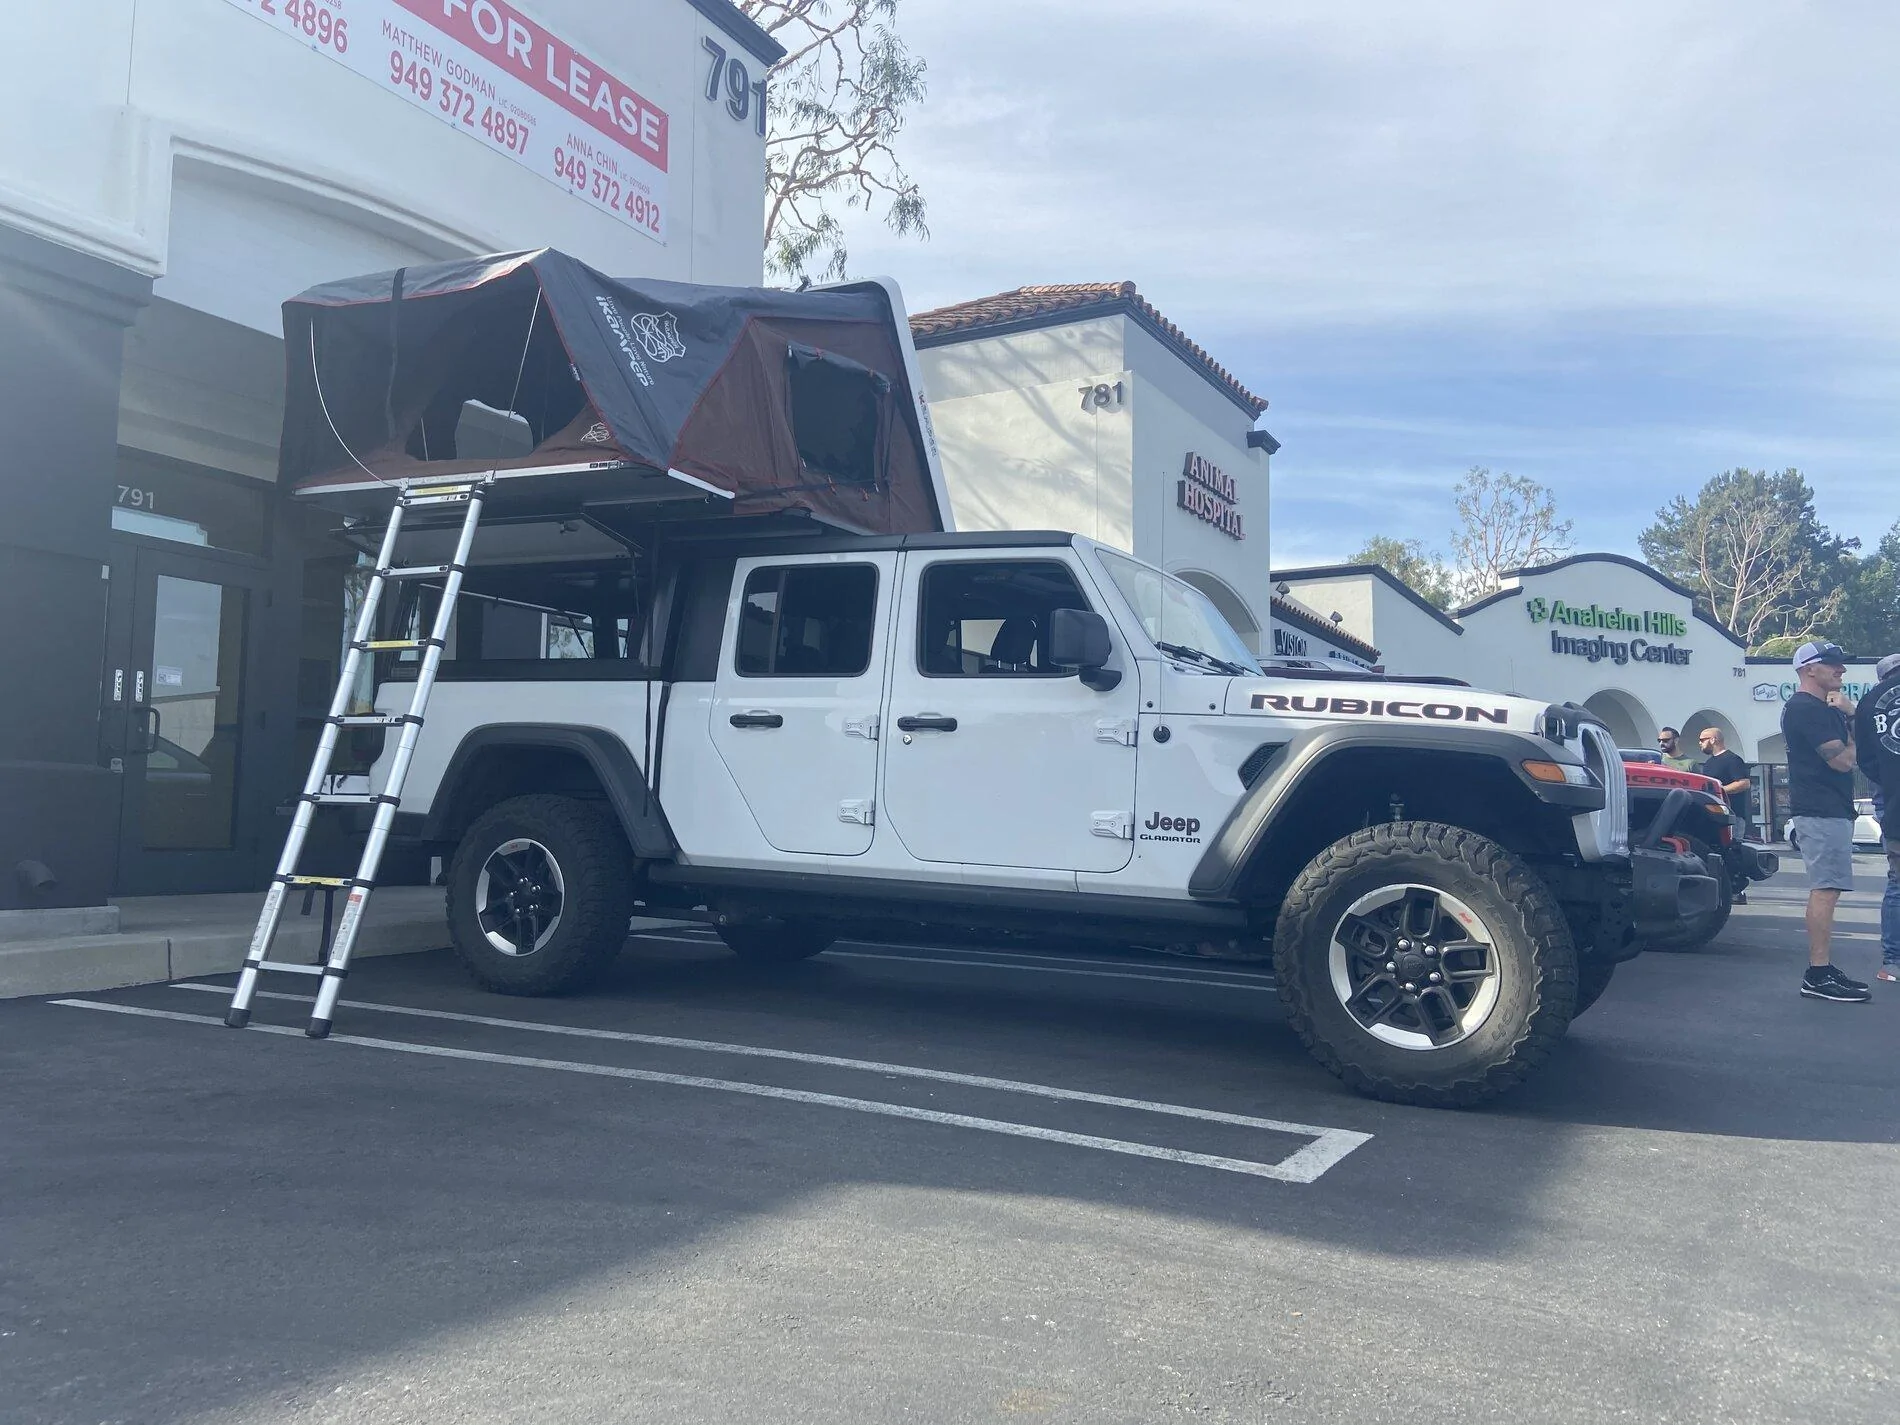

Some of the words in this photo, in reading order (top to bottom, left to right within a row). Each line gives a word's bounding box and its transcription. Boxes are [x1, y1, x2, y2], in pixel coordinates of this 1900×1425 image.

[284, 0, 348, 54] 4896
[381, 19, 443, 69] MATTHEW
[445, 58, 496, 101] GODMAN
[389, 49, 433, 101] 949
[438, 76, 475, 128] 372
[480, 105, 530, 156] 4897
[546, 43, 661, 153] LEASE
[701, 35, 767, 138] 791
[566, 132, 594, 161] ANNA
[595, 150, 619, 176] CHIN
[553, 146, 587, 191] 949
[591, 167, 620, 212] 372
[624, 190, 660, 234] 4912
[1077, 380, 1123, 411] 781
[117, 484, 154, 509] 791
[1176, 479, 1246, 541] HOSPITAL
[1551, 599, 1642, 633] Anaheim
[1643, 609, 1688, 637] Hills
[1551, 630, 1628, 666] Imaging
[1629, 637, 1693, 666] Center
[1249, 693, 1509, 725] RUBICON
[1139, 833, 1202, 844] GLADIATOR
[1144, 811, 1201, 836] Jeep
